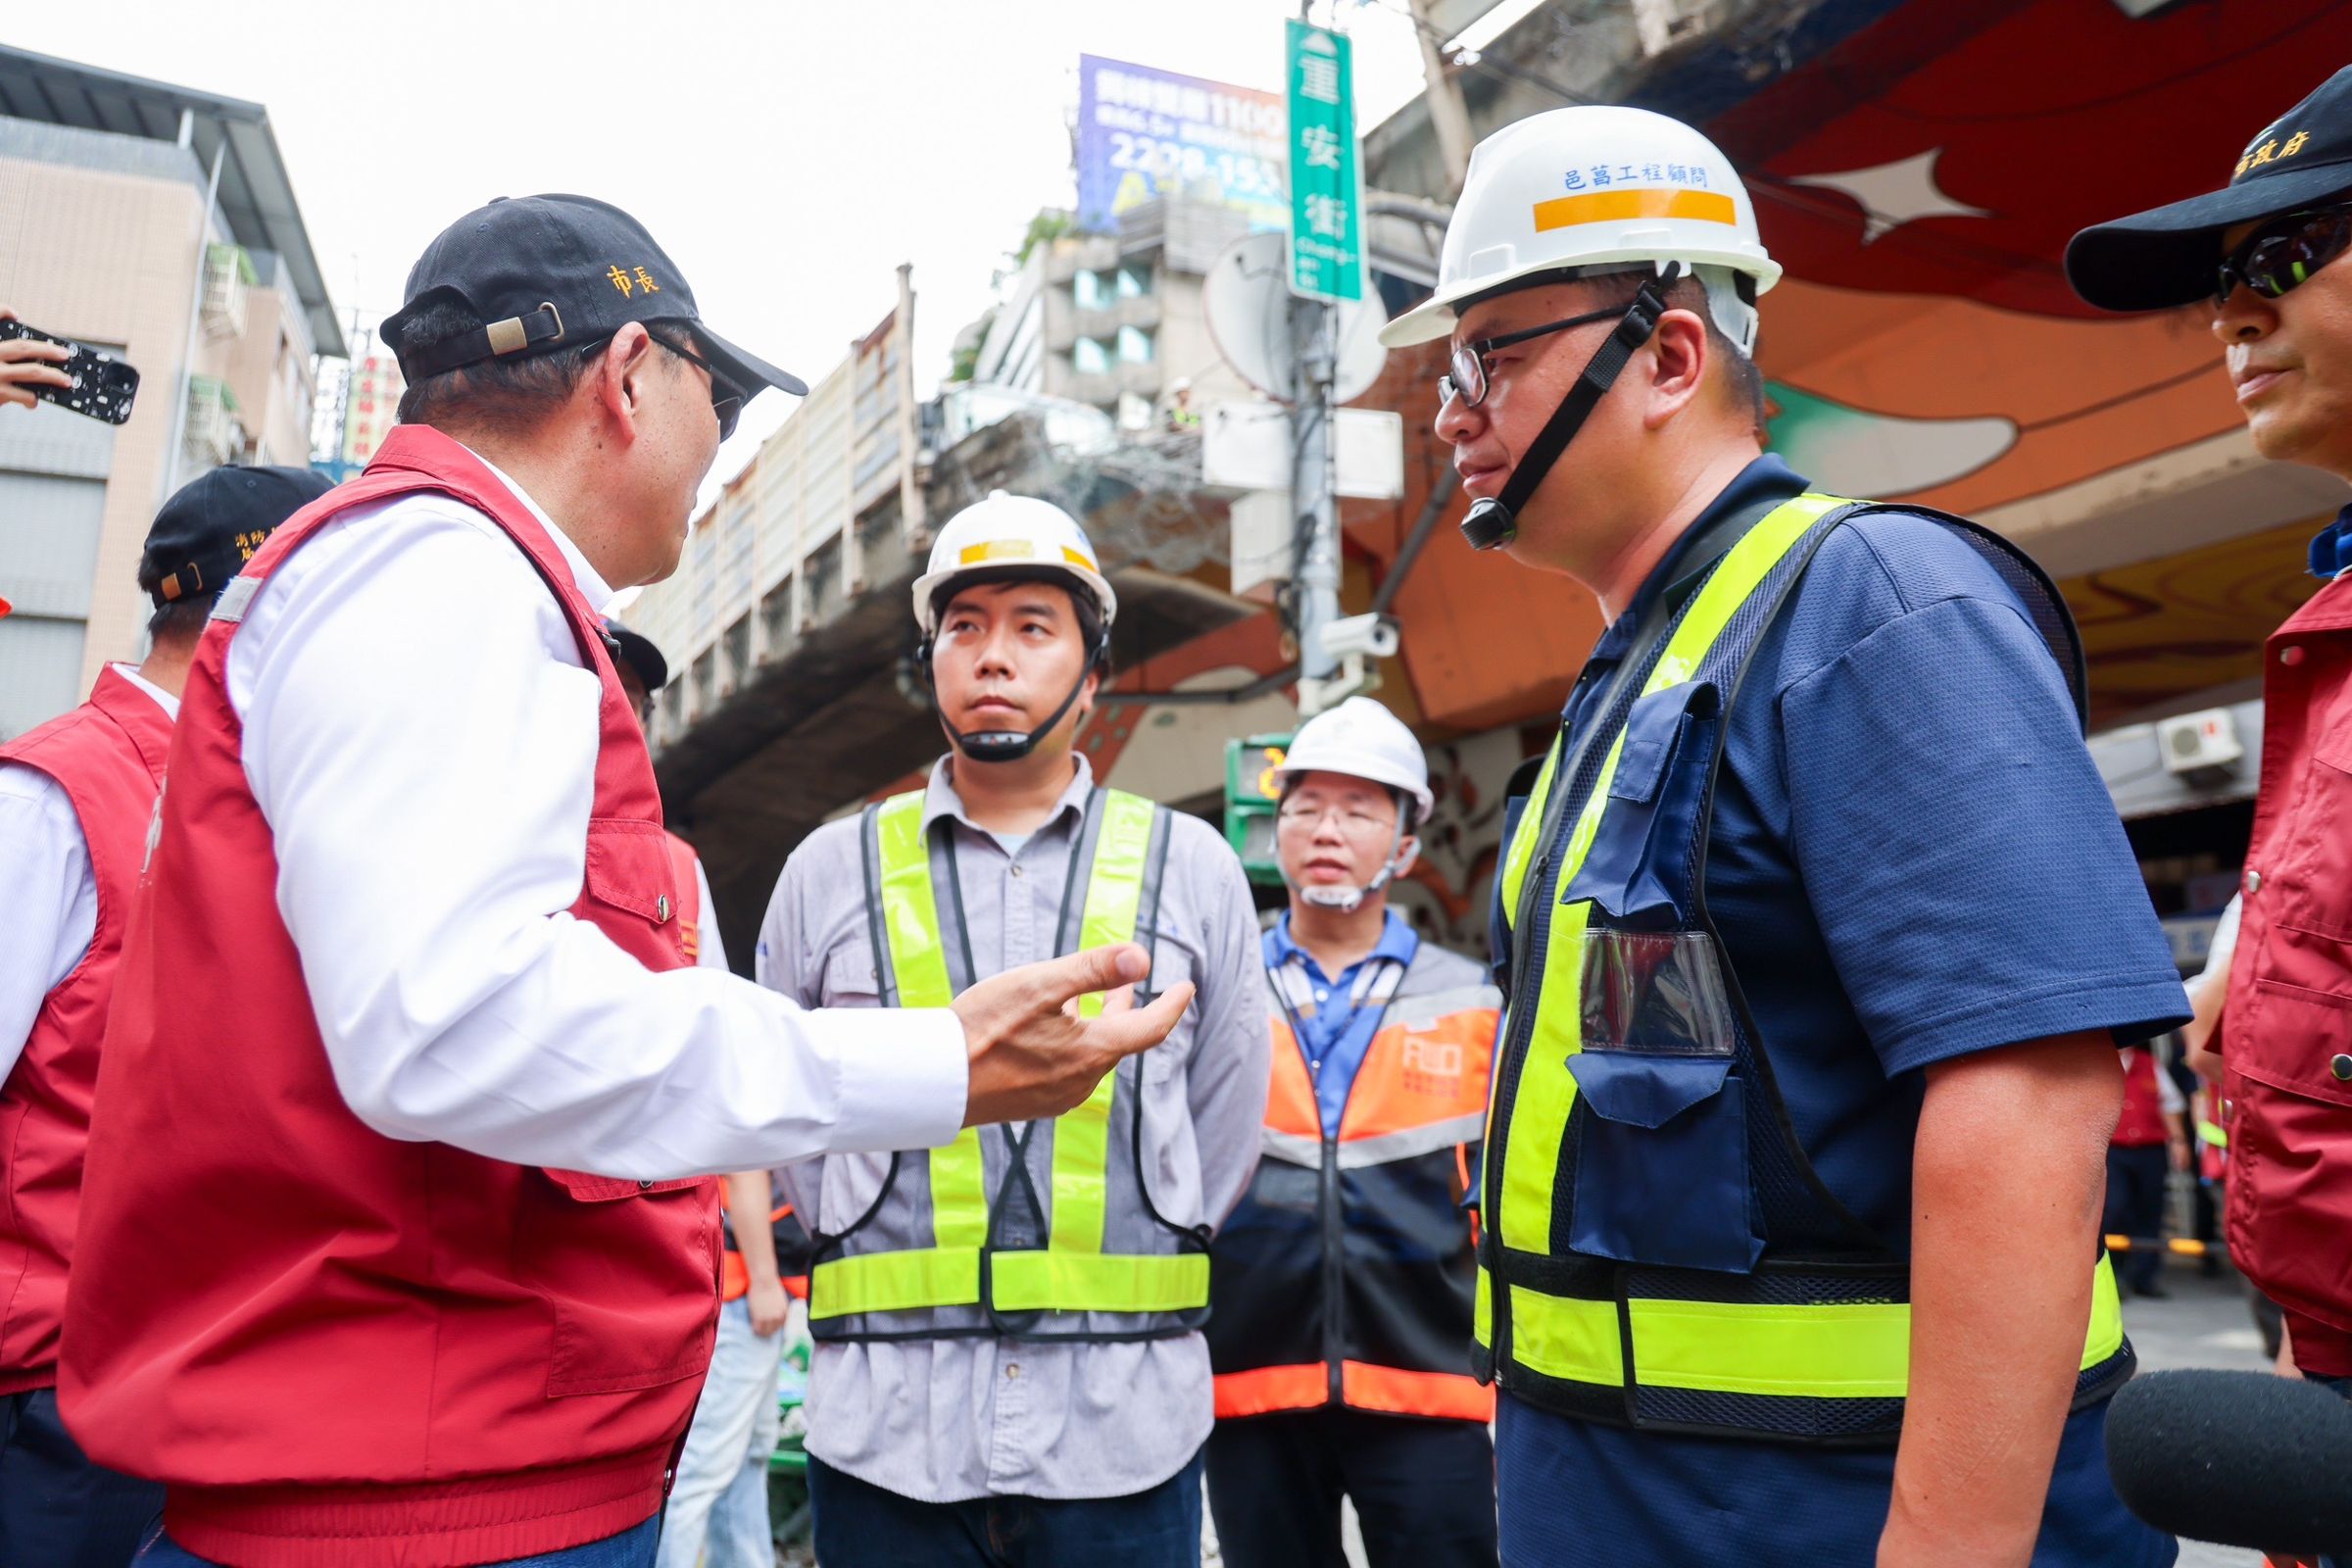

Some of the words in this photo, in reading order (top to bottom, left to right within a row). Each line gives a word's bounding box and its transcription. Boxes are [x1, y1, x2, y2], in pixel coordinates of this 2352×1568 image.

[1298, 55, 1348, 241] 重安街
[1564, 163, 1708, 190] 邑菖工程顧問
[607, 265, 660, 298] 市長
[236, 526, 277, 547] 消防
